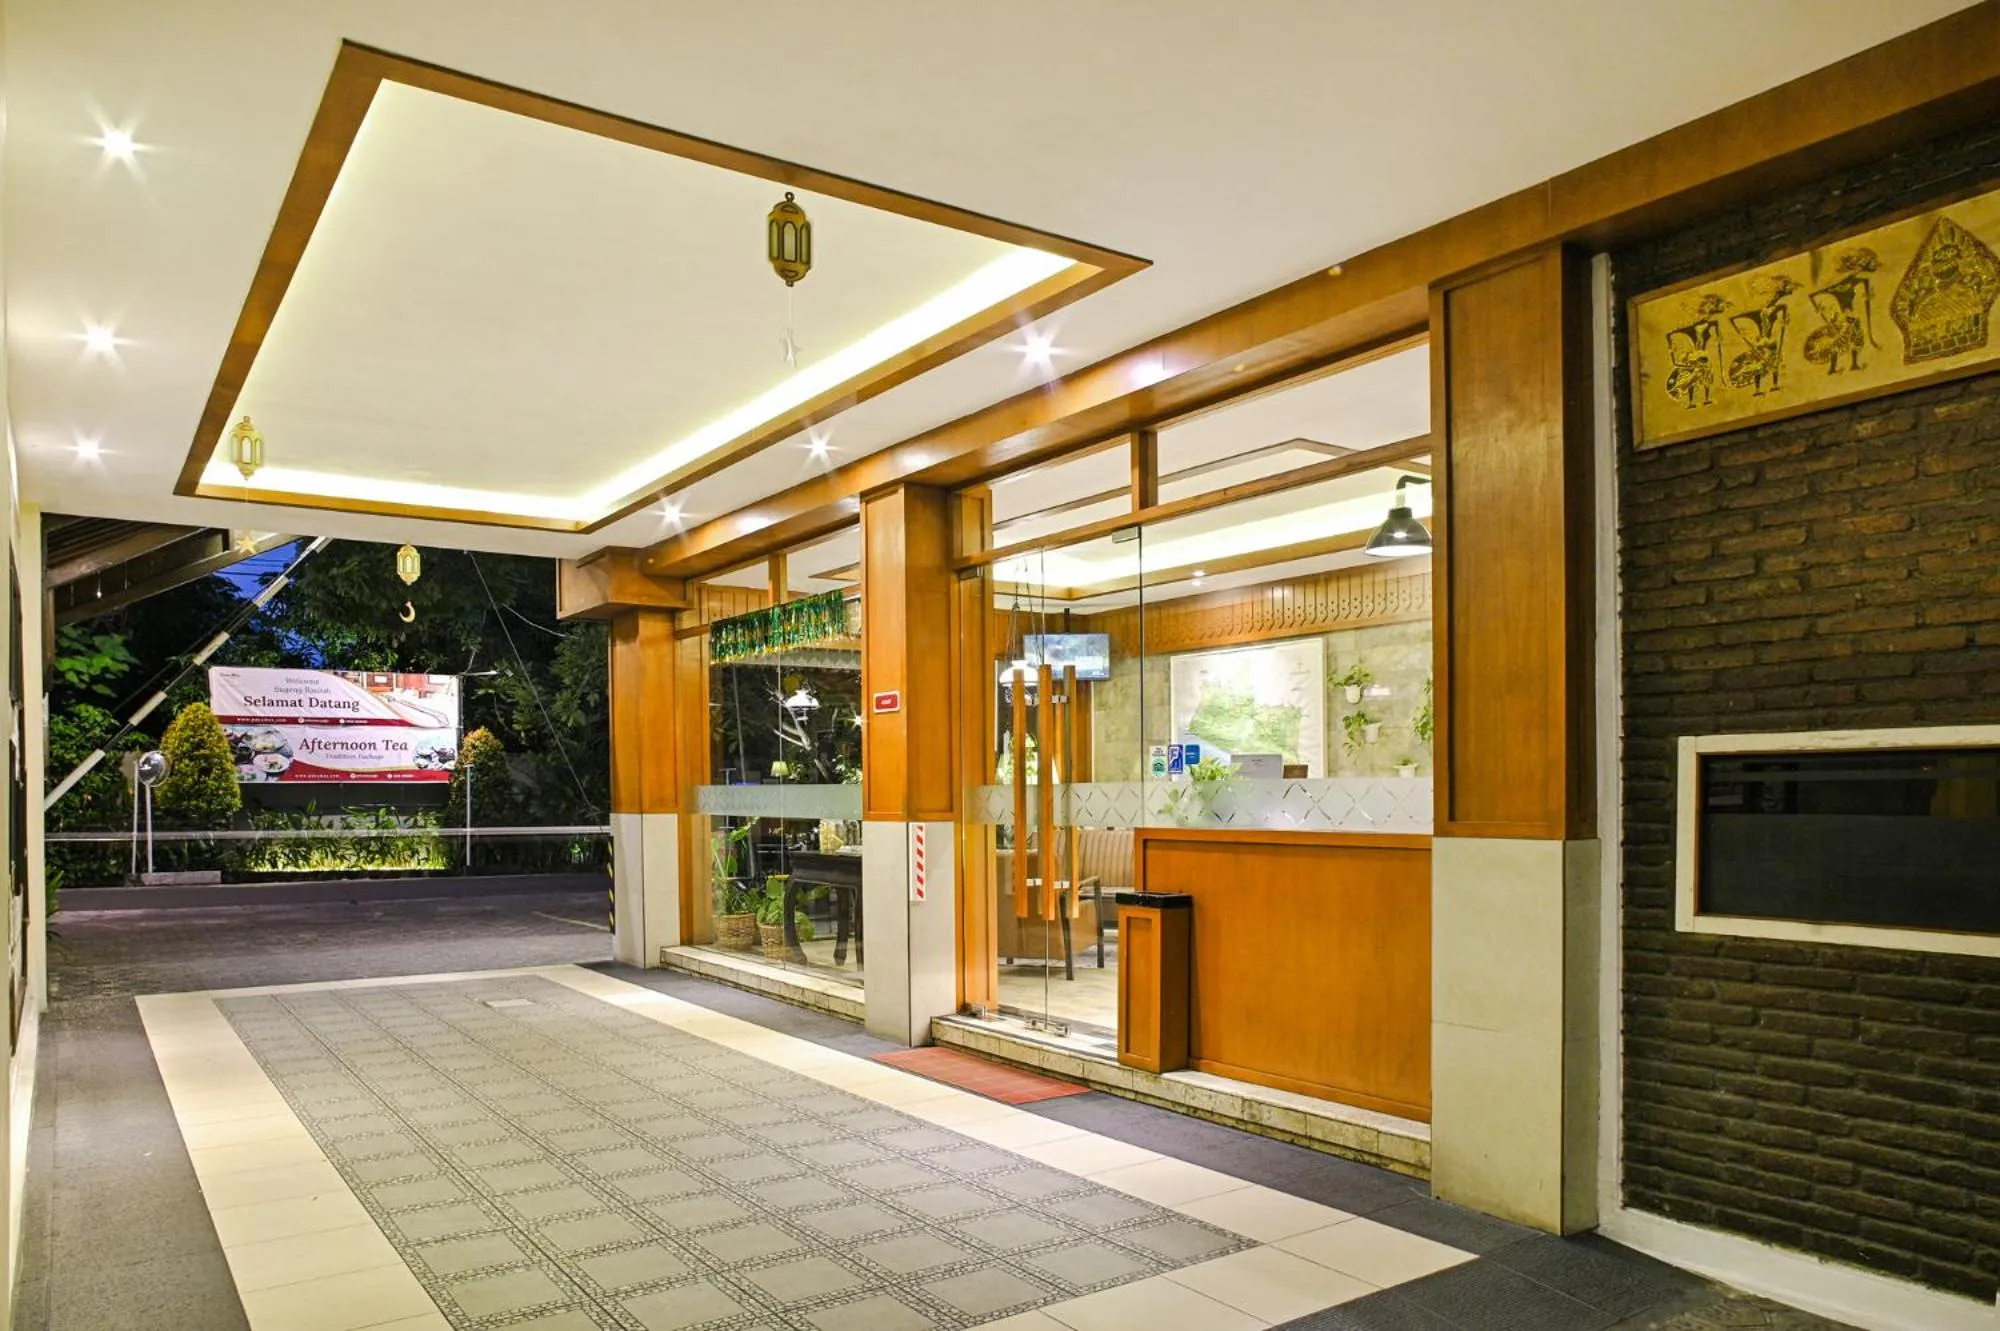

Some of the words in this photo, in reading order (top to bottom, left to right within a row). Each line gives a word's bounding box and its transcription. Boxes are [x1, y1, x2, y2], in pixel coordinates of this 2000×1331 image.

[243, 695, 304, 708] Selamat
[308, 696, 360, 712] Datang
[299, 737, 377, 754] Afternoon
[382, 739, 408, 751] Tea
